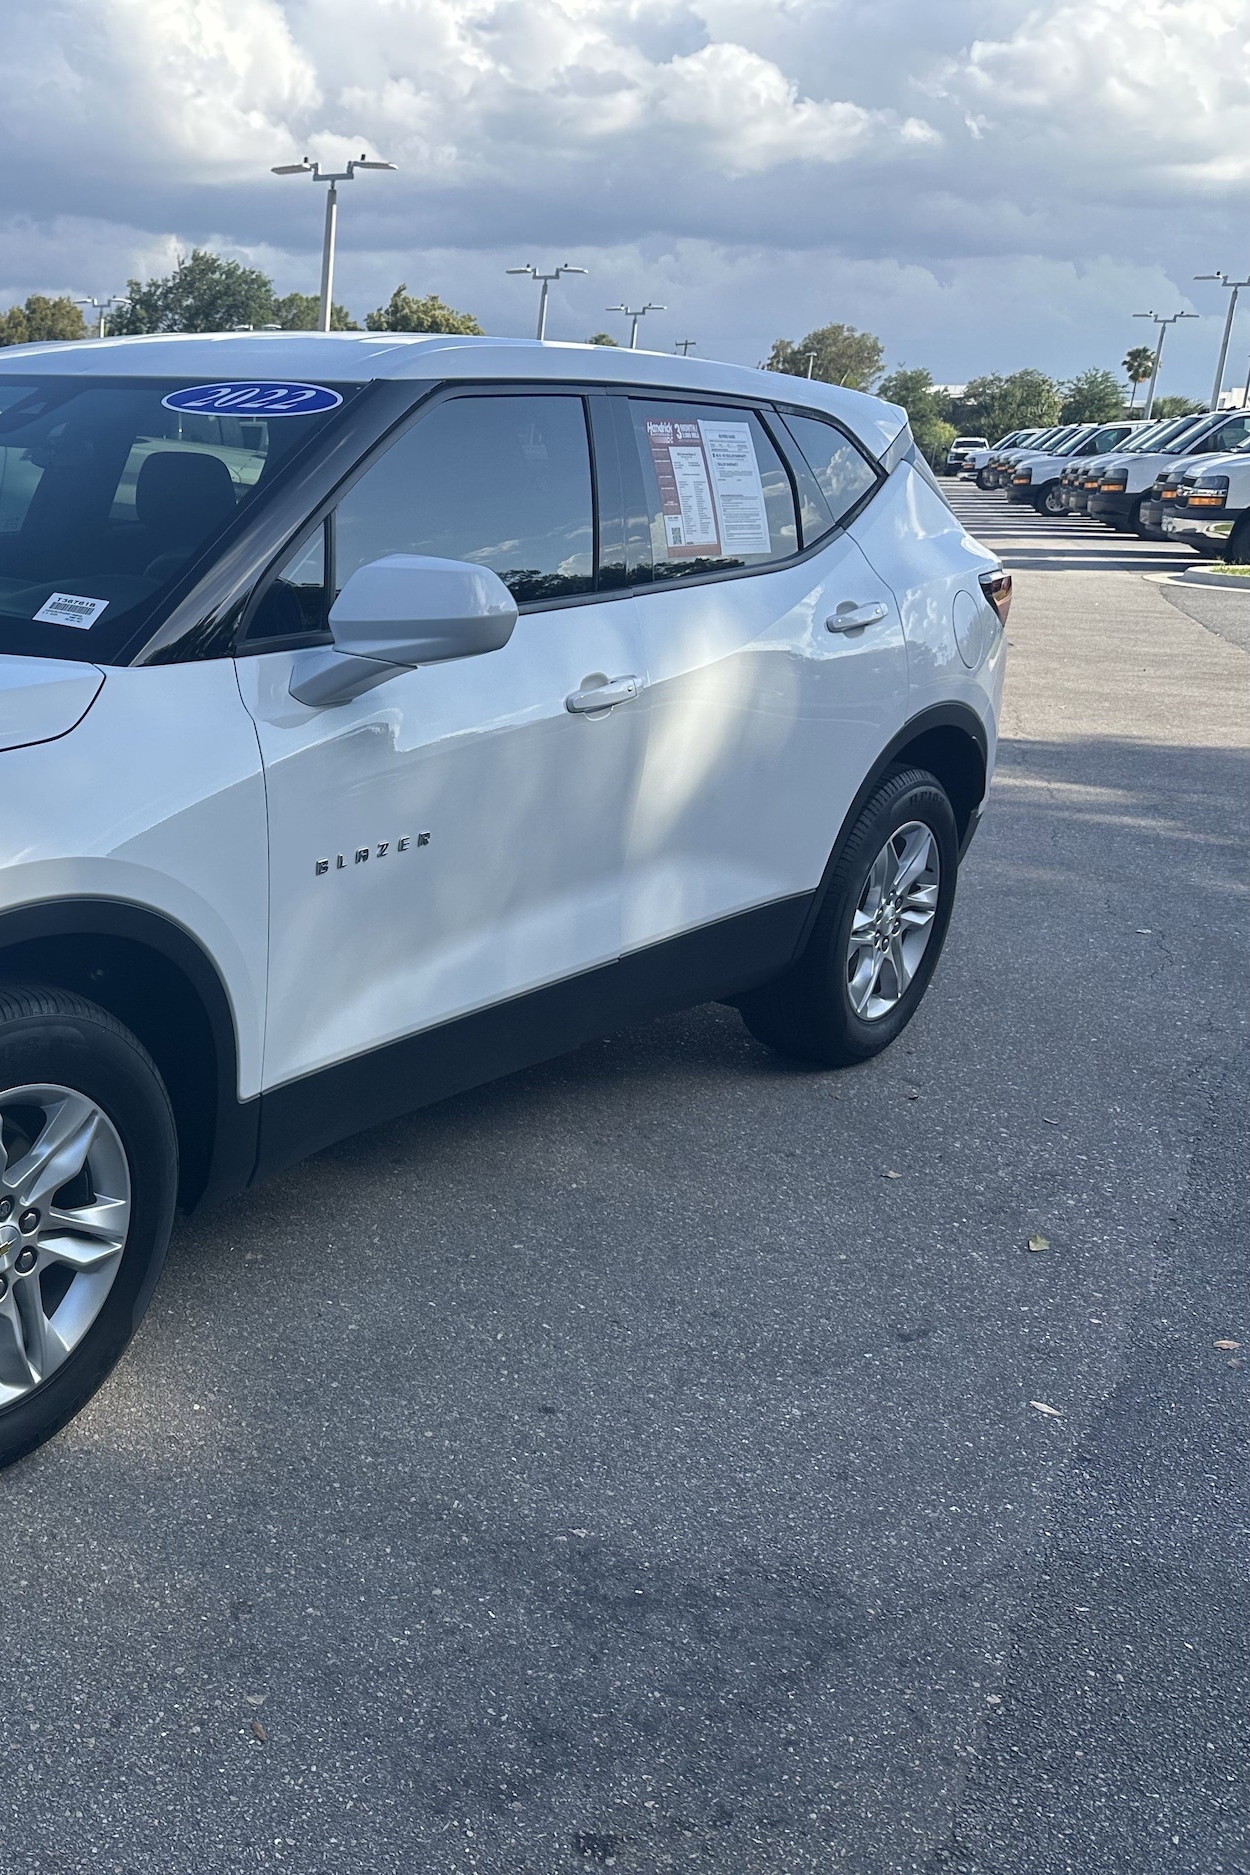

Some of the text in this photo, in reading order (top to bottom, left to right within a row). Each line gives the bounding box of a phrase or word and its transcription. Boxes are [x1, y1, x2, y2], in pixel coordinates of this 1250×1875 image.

[181, 387, 317, 410] 2022
[646, 421, 673, 436] Hendrick
[674, 423, 682, 439] 3
[315, 830, 431, 876] BLAZER
